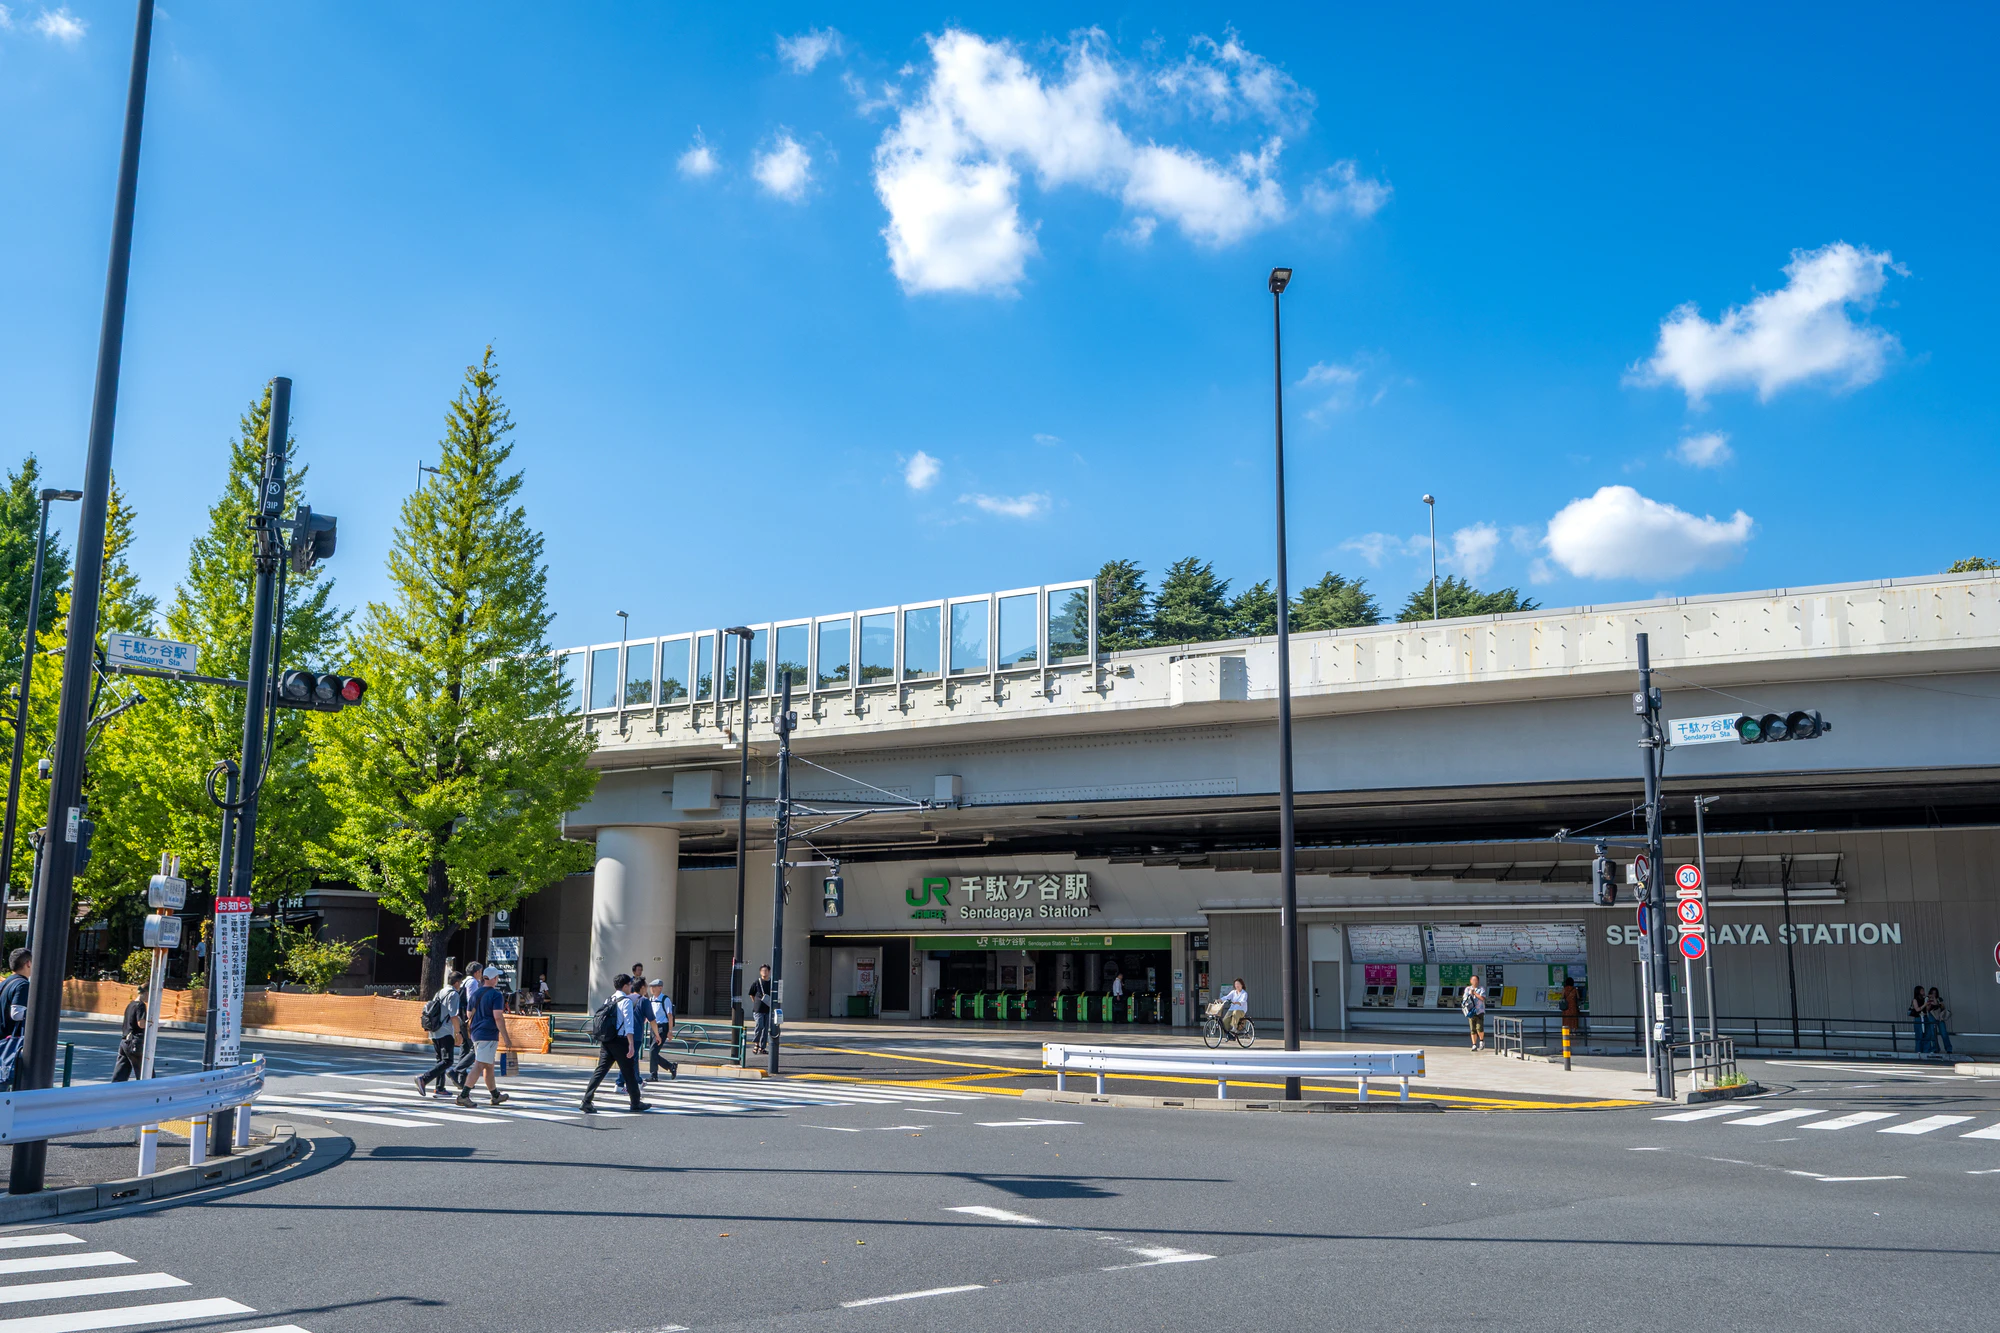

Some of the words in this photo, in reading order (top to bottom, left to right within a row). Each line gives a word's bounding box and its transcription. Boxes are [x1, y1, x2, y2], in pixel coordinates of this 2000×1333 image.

[124, 652, 164, 665] Sendagaya
[168, 658, 182, 667] Sta.
[1683, 733, 1717, 742] Sendagaya
[1681, 872, 1696, 884] 30
[905, 877, 952, 906] JR
[960, 906, 1032, 922] Sendagaya
[1039, 904, 1088, 918] Station
[1606, 924, 1770, 945] SEDAYA
[1779, 922, 1902, 945] STATION
